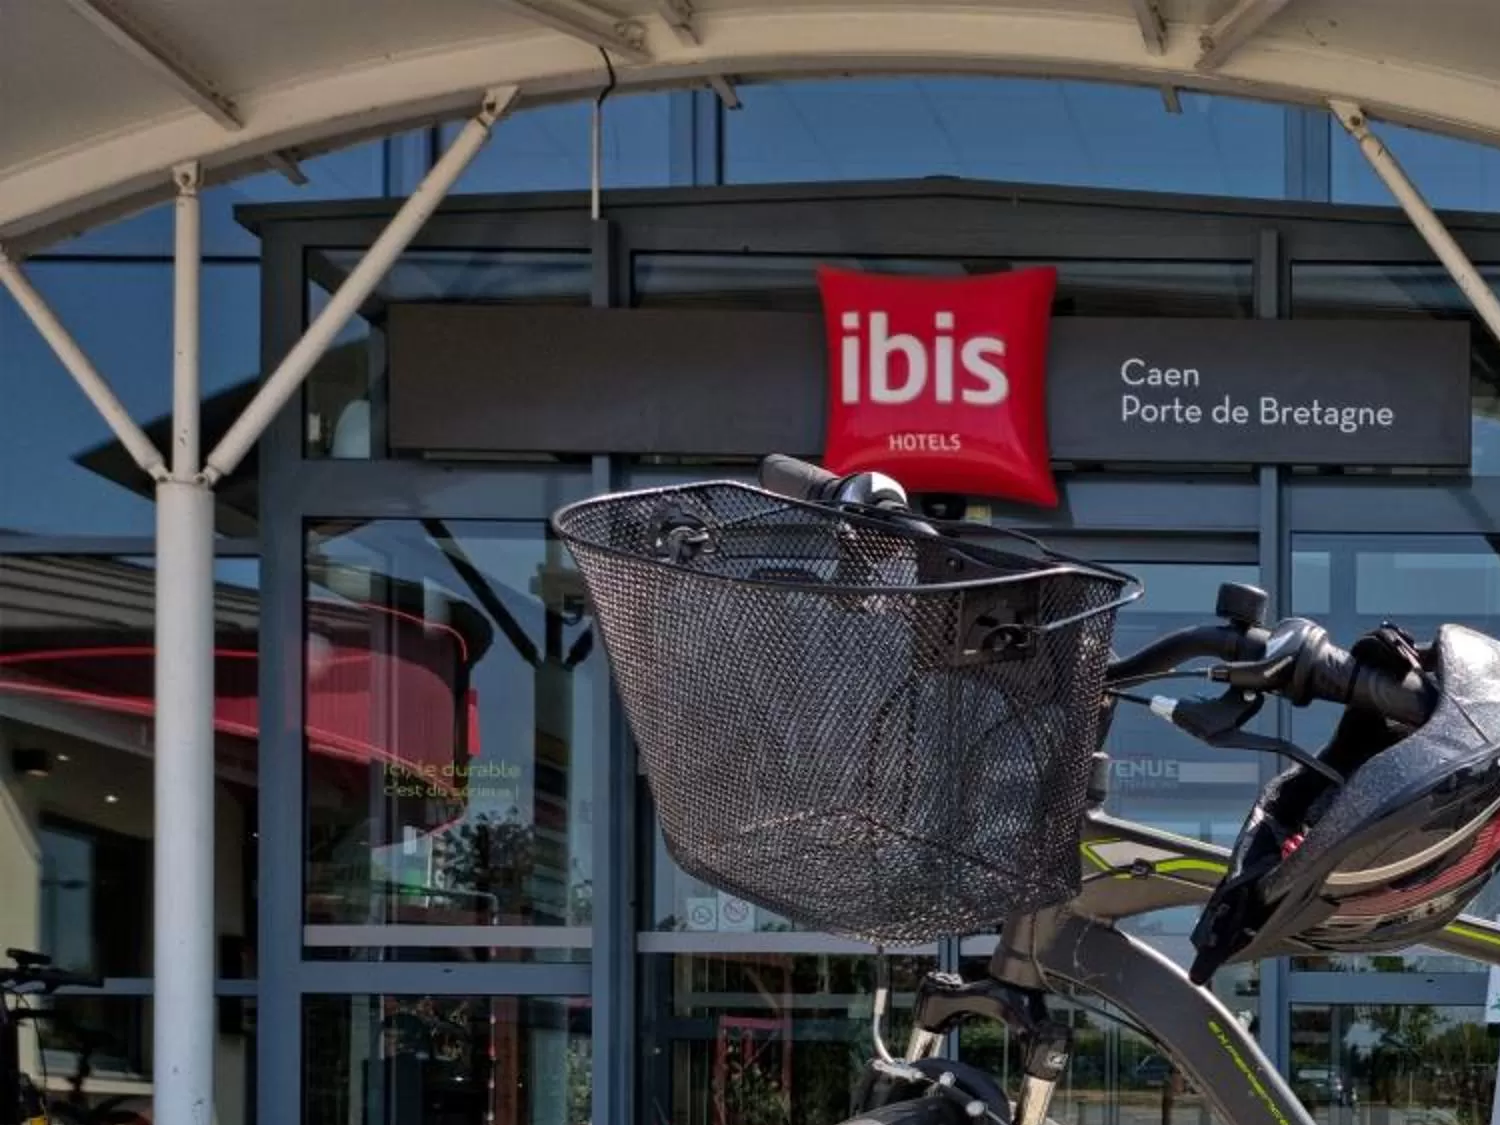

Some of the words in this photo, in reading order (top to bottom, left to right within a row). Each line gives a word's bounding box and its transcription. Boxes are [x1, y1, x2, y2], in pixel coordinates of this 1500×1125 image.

[841, 310, 1010, 406] ibis
[1120, 357, 1201, 388] Caen
[1120, 395, 1203, 424] Porte
[1211, 394, 1250, 425] de
[1259, 396, 1395, 434] Bretagne
[889, 432, 962, 451] HOTELS
[442, 758, 522, 778] durable
